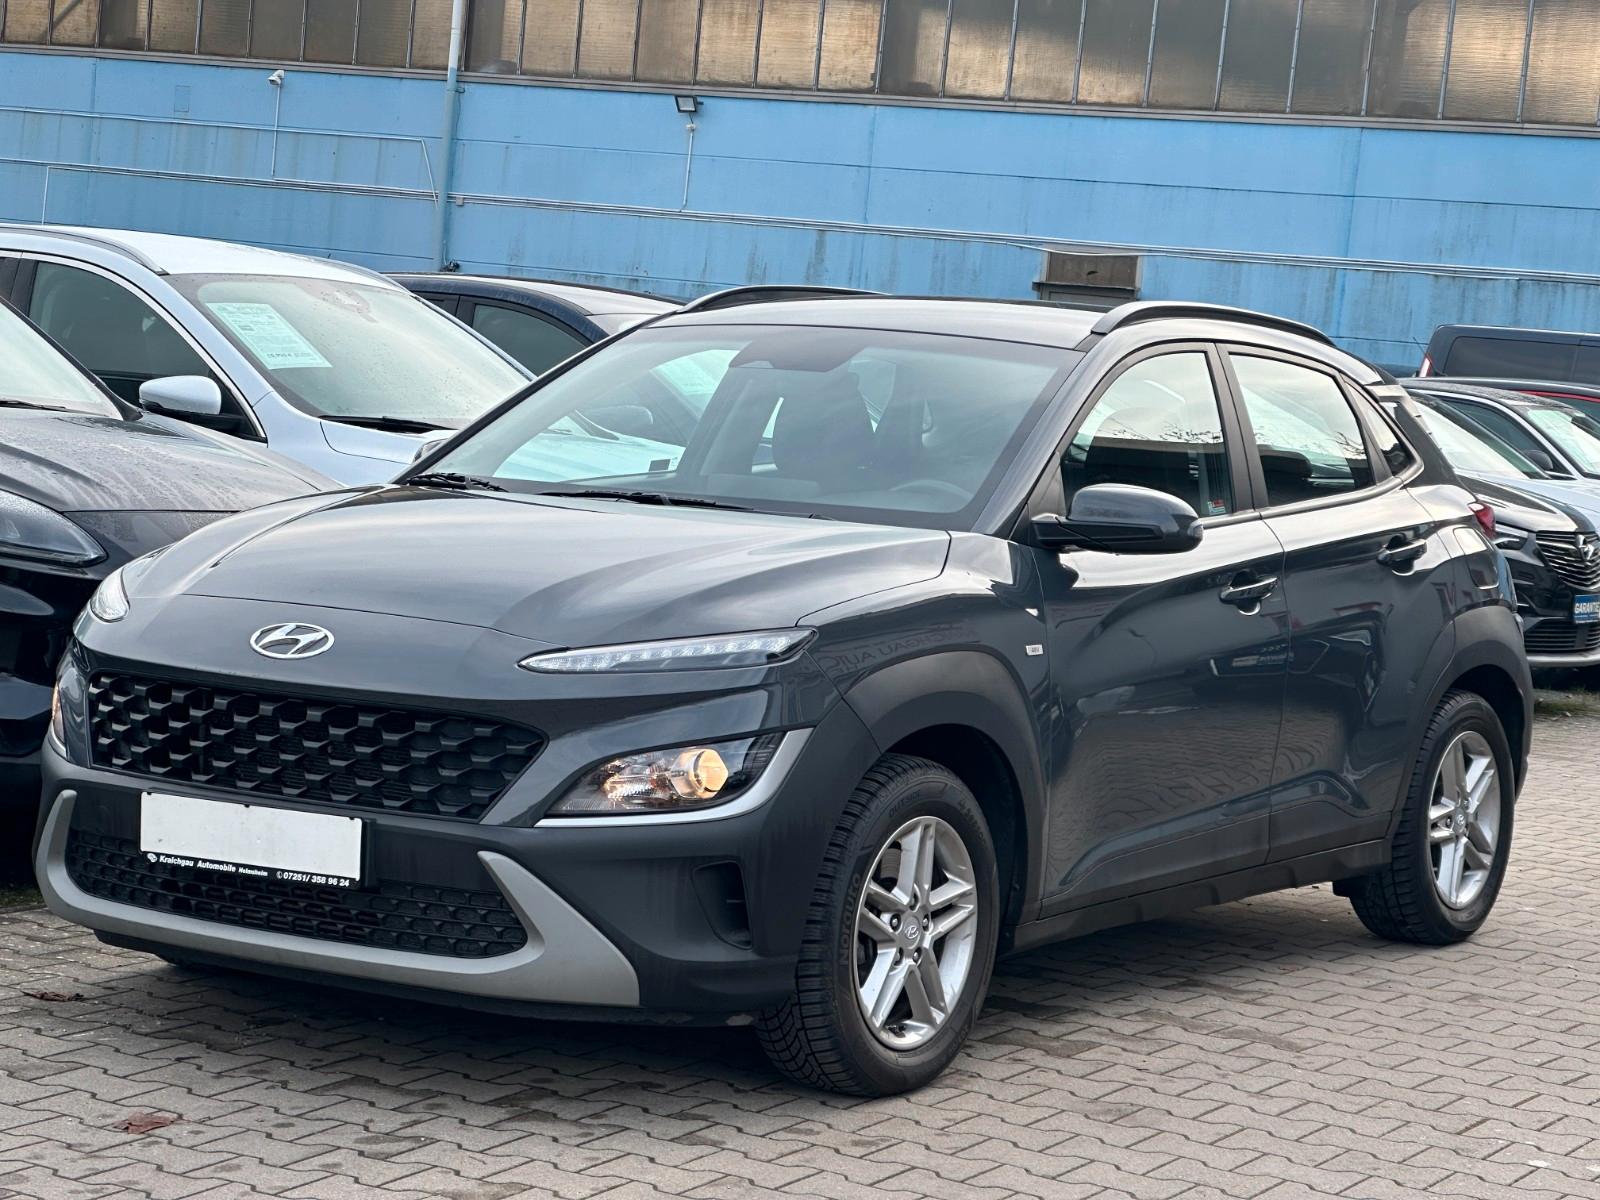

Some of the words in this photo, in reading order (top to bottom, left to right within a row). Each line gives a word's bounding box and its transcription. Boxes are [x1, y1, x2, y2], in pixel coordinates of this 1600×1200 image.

[159, 855, 194, 867] Kraichgau
[197, 860, 236, 872] Automobile
[311, 875, 327, 884] 358
[339, 879, 350, 887] 24
